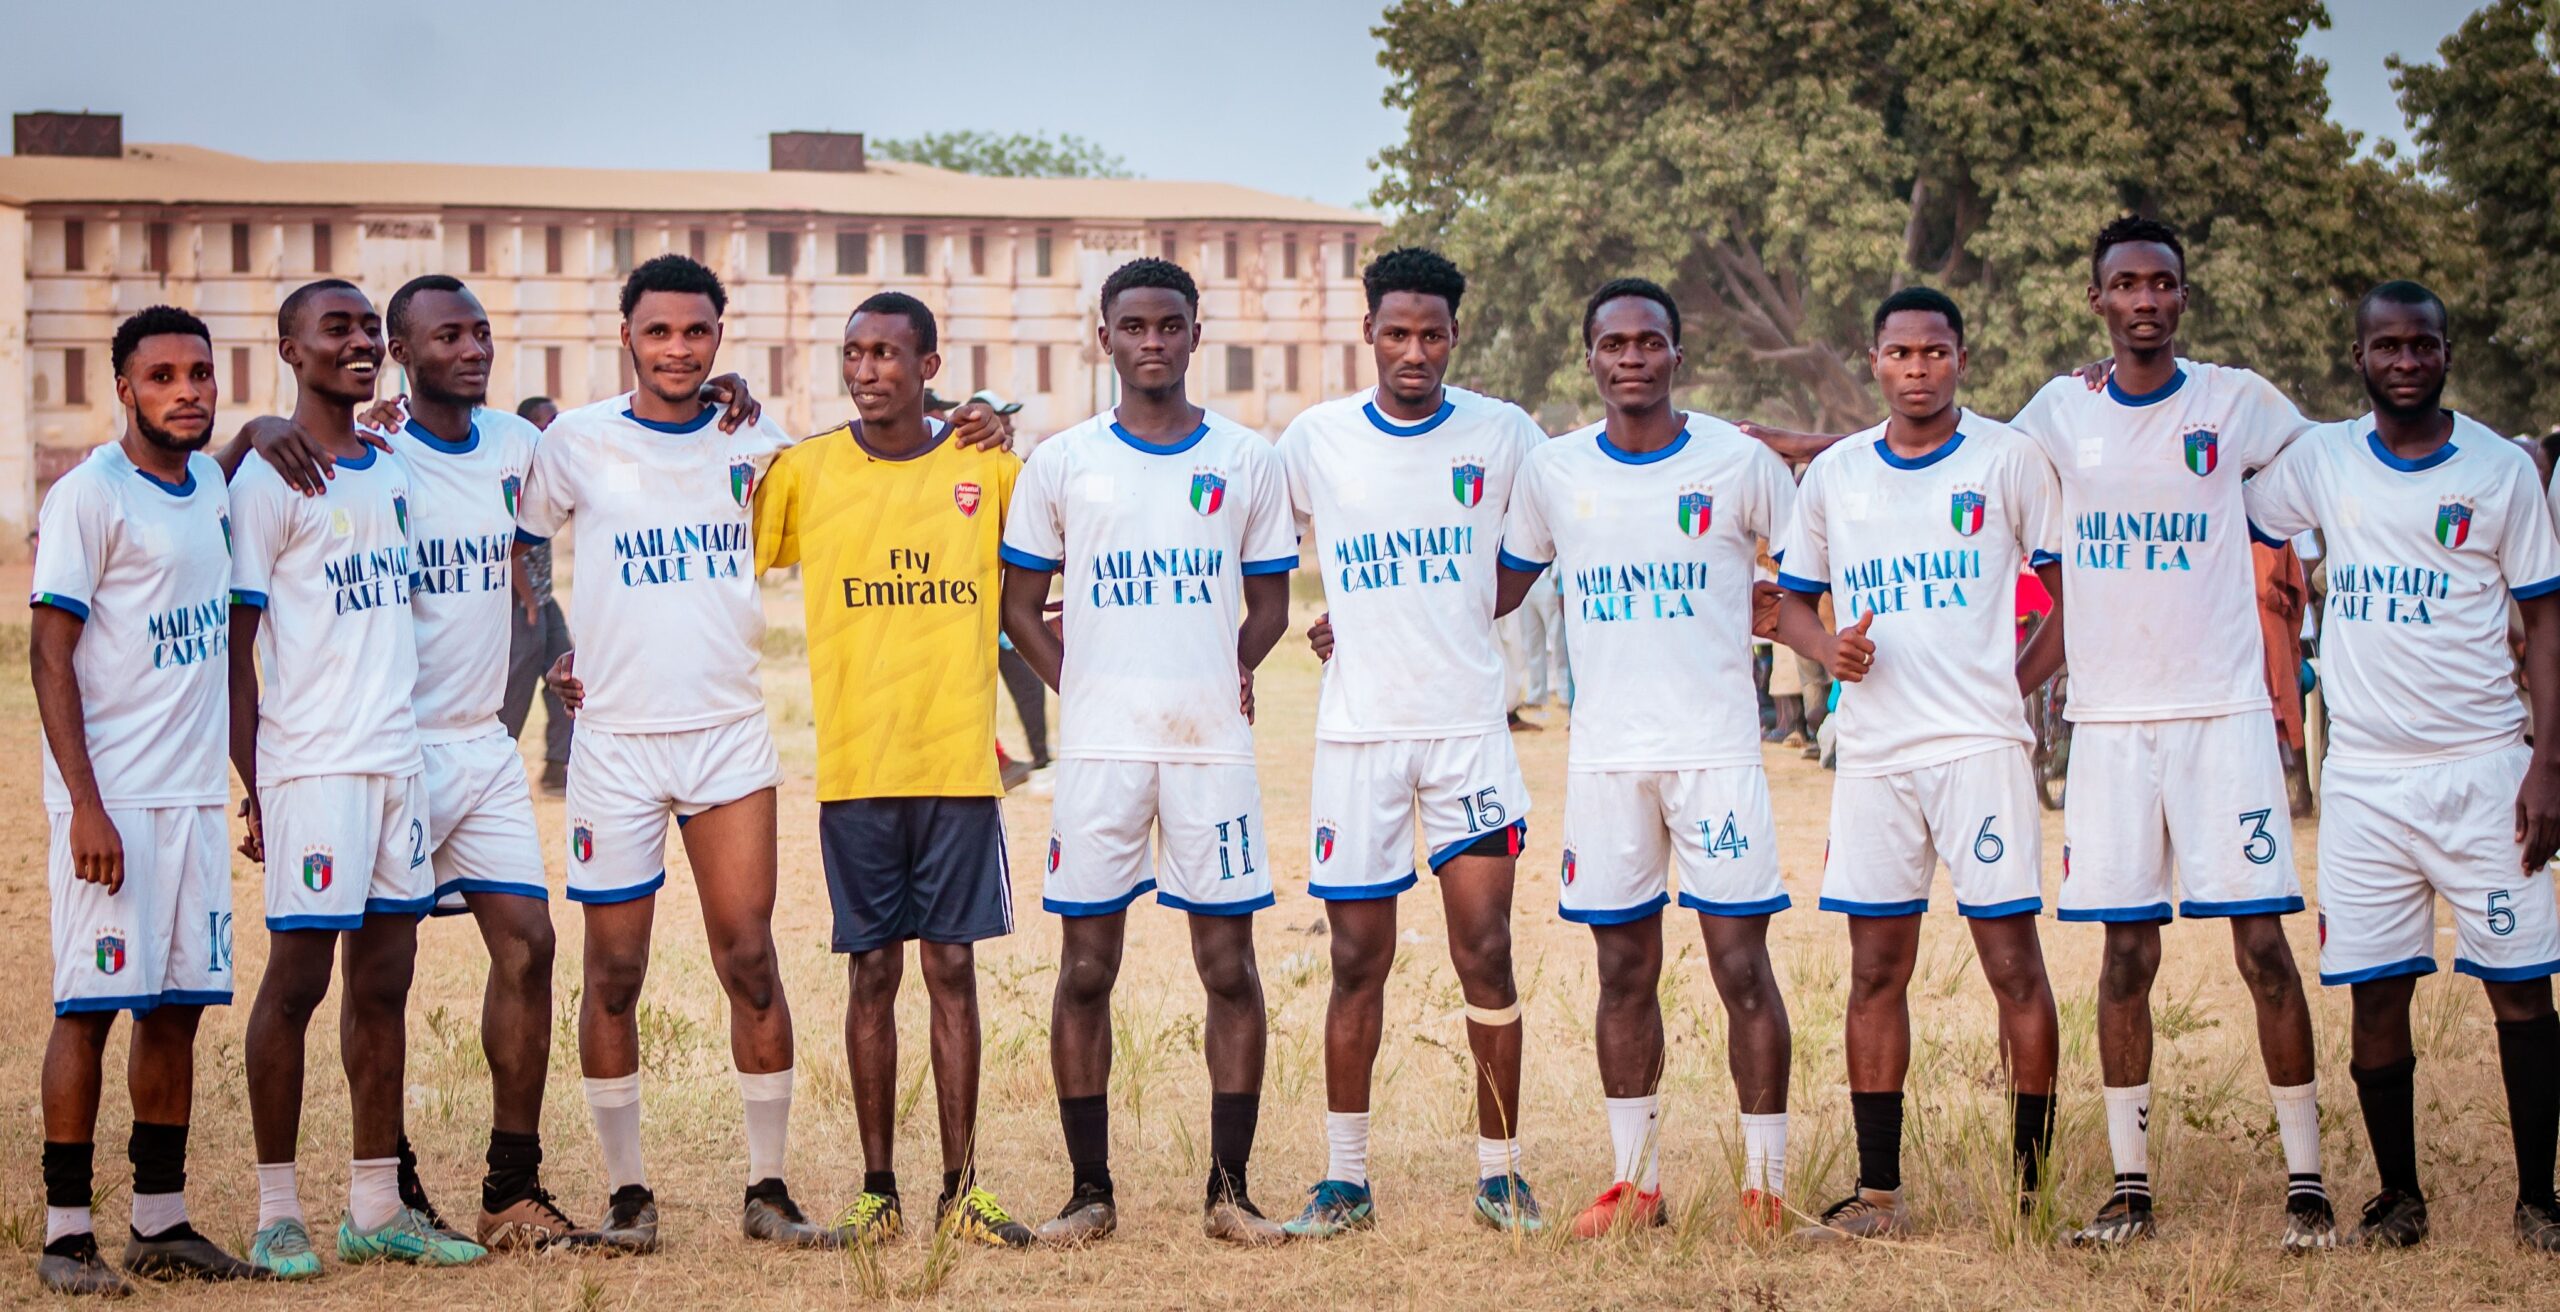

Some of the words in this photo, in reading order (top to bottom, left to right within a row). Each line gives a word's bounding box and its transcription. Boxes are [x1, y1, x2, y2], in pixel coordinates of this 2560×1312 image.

[890, 548, 930, 574] Fly
[1334, 526, 1472, 566] MAILANTARKI
[2076, 542, 2131, 570] CARE
[2145, 545, 2190, 571] F.A
[417, 566, 470, 595] ARE
[621, 556, 694, 587] CARE
[1341, 560, 1406, 593] CARE
[1419, 558, 1461, 583] F.A
[1576, 561, 1707, 596] MAILANTARKI
[1843, 549, 1979, 593] MAILANTARKI
[336, 578, 388, 615] CARE
[843, 574, 978, 608] Emirates
[1092, 579, 1160, 608] CARE
[1174, 579, 1212, 604] F.A
[1653, 592, 1695, 618] F.A
[1850, 585, 1911, 620] CARE
[1923, 582, 1968, 609] F.A
[2388, 597, 2431, 624] F.A
[1458, 786, 1506, 834] 15
[410, 817, 426, 870] 2
[1215, 814, 1255, 880] 11
[1696, 809, 1749, 859] 14
[1974, 815, 2004, 863] 6
[2238, 808, 2277, 865] 3
[2487, 889, 2516, 936] 5
